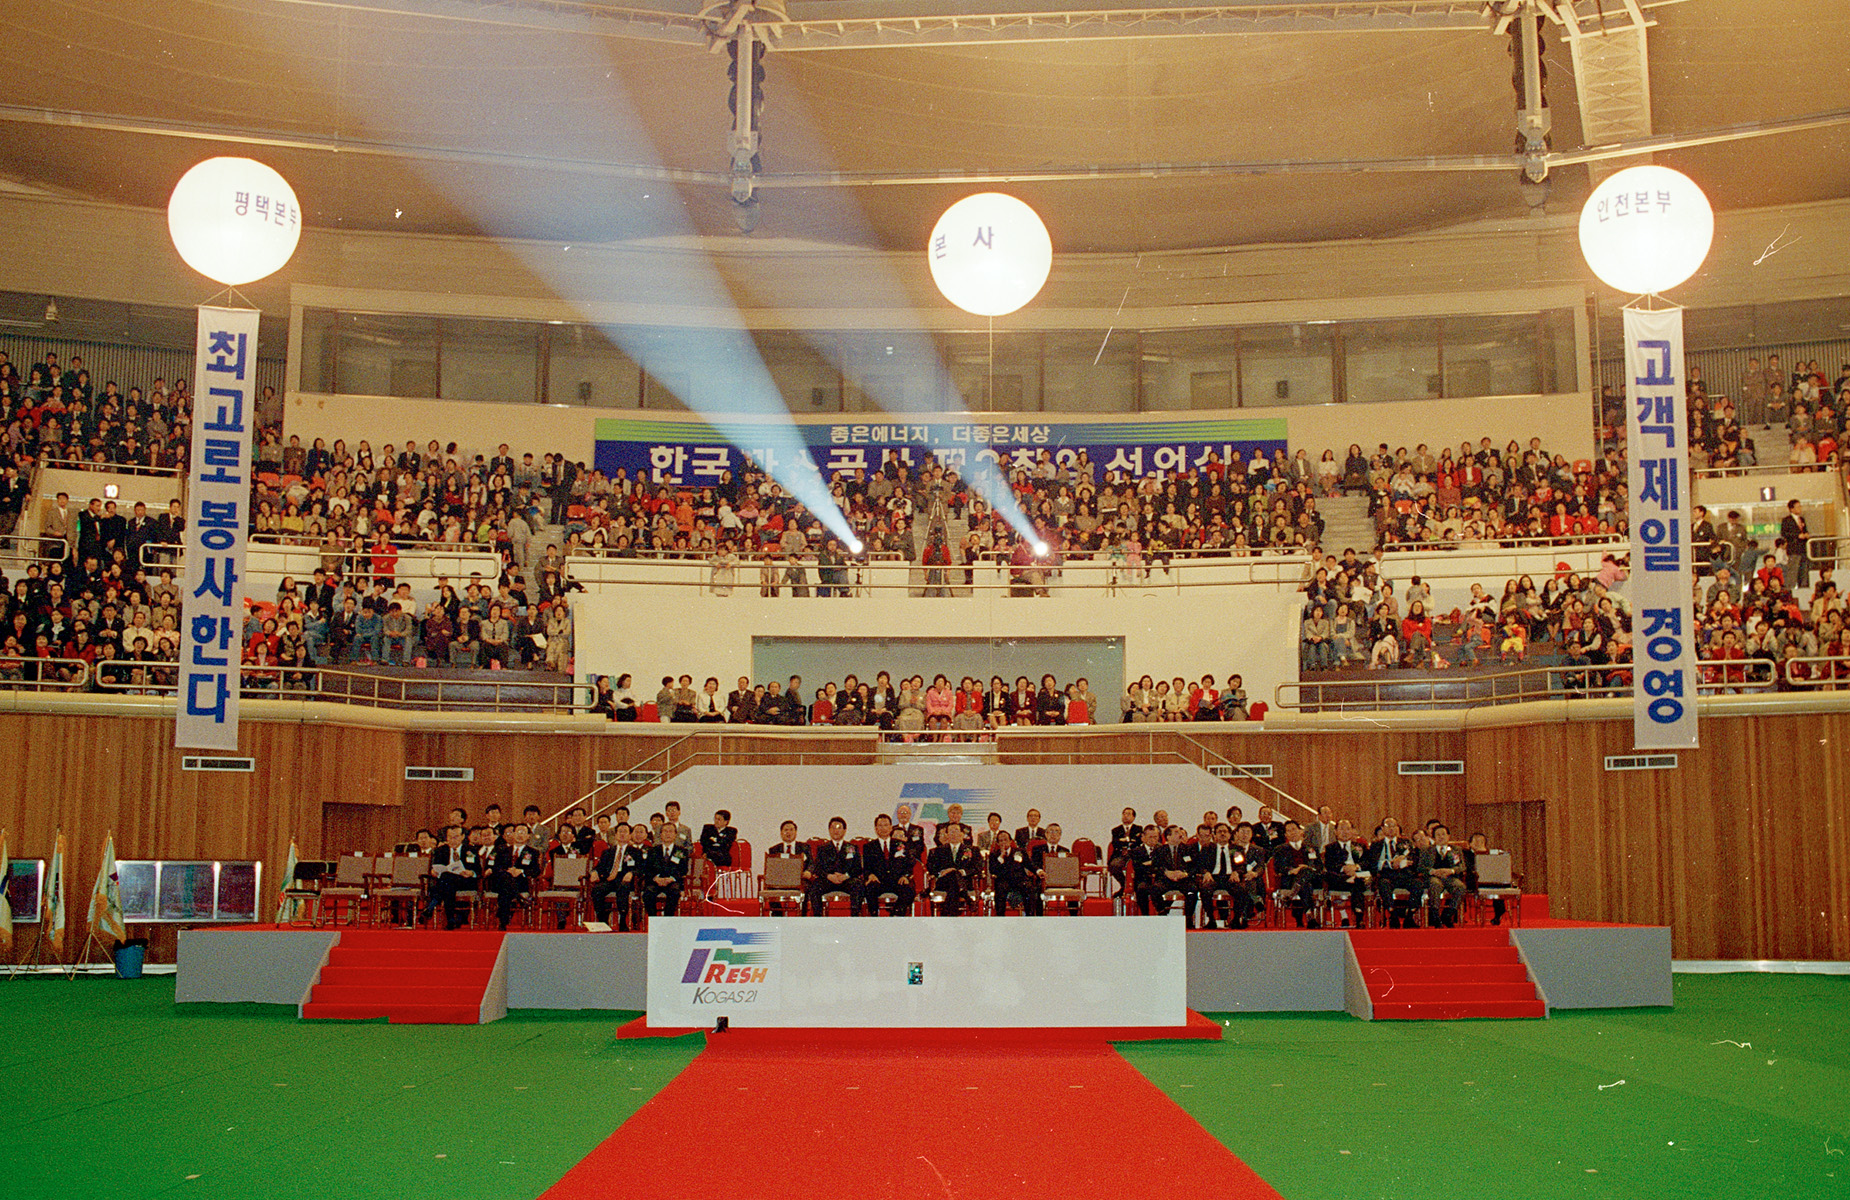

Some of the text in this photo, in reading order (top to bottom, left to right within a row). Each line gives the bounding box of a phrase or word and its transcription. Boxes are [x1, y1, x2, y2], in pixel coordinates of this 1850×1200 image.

[235, 191, 297, 231] 평택본부
[1597, 189, 1672, 222] 인천본부
[952, 425, 1050, 444] 더좋은세상
[105, 484, 118, 498] 10
[1763, 487, 1772, 501] 1
[186, 330, 247, 724] 최고로 봉사한다
[1642, 607, 1684, 724] 경영
